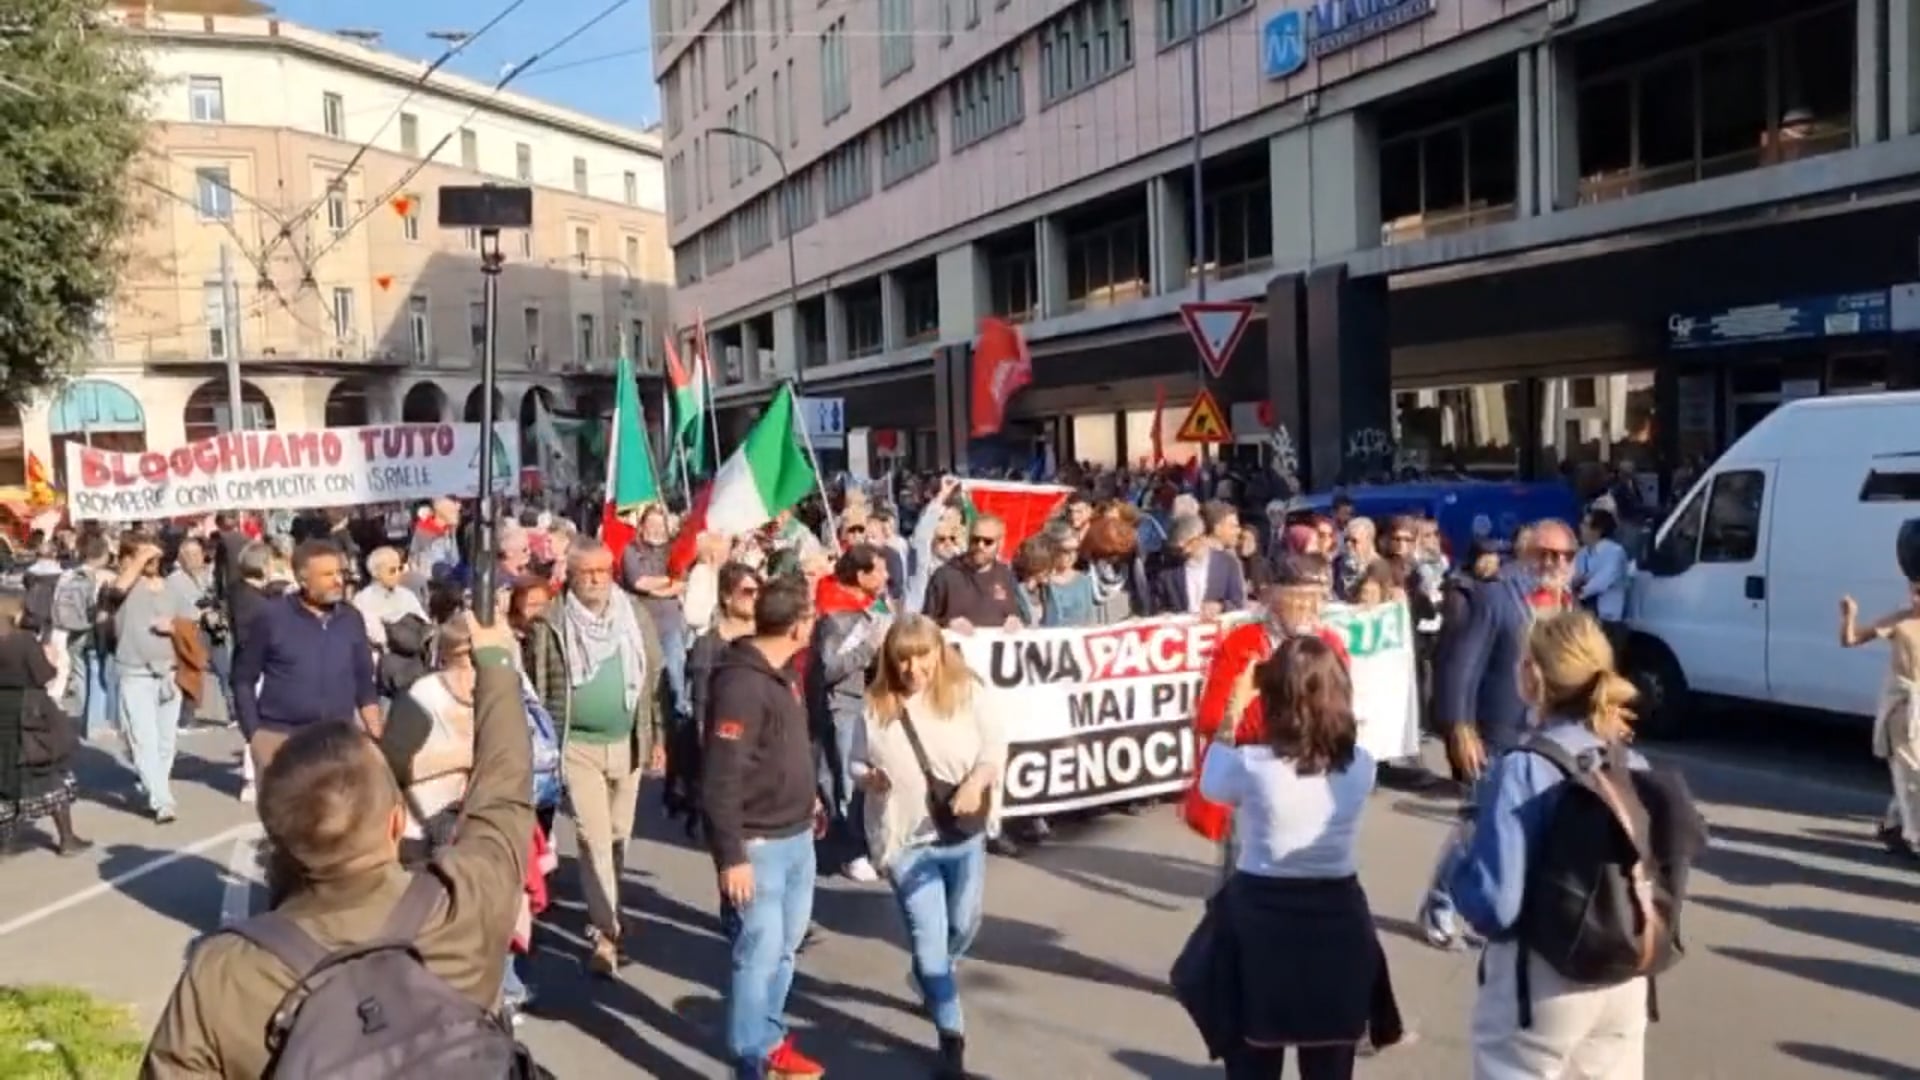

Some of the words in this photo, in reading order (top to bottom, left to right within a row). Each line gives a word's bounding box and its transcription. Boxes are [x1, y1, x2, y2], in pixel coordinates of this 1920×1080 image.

[358, 424, 454, 462] TUTTO
[76, 481, 166, 514] ROMPERE
[176, 482, 219, 507] OGNI
[324, 473, 356, 494] CON
[368, 465, 432, 494] ISRAELE
[990, 641, 1082, 688] UNA
[1094, 623, 1217, 680] PACE
[1068, 686, 1135, 729] MAI
[1006, 726, 1194, 799] GENOCI
